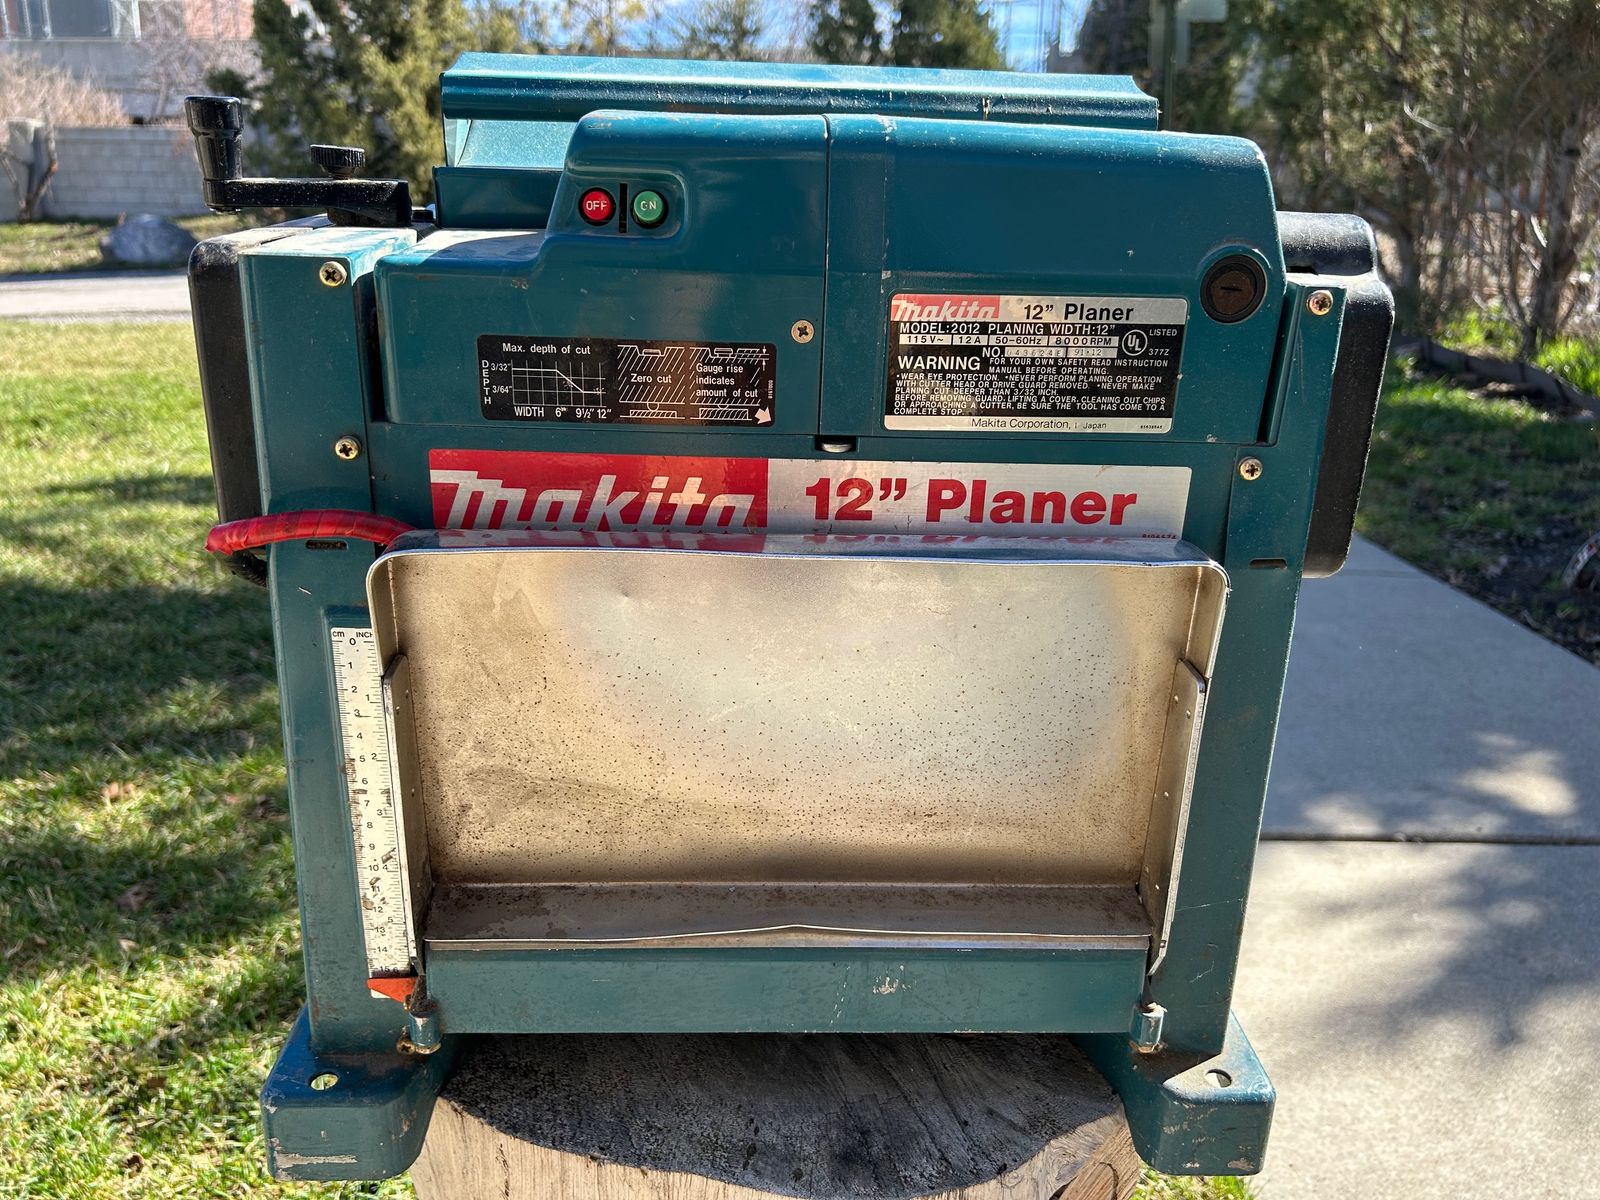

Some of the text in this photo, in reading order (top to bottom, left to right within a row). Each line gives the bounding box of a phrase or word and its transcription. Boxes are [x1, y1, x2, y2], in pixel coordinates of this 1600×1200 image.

[586, 200, 607, 211] OFF
[1064, 303, 1134, 321] Planer
[900, 322, 980, 334] MODEL:2012
[988, 323, 1044, 335] PLANING
[1149, 328, 1177, 336] LISTED
[502, 343, 591, 354] Max. depth of cut
[982, 347, 1004, 358] NO.
[1148, 348, 1170, 356] 377Z
[696, 363, 743, 373] Gauge rise
[898, 356, 980, 370] WARNING
[989, 366, 1022, 374] MANUAL
[631, 373, 672, 383] Zero cut
[696, 375, 735, 385] indicates
[920, 380, 951, 388] CUTTER
[992, 381, 1015, 389] DRIVE
[696, 387, 727, 397] amount
[733, 388, 741, 397] of
[744, 388, 758, 398] cut
[895, 387, 930, 395] PLANING
[988, 388, 1010, 396] THAN
[1007, 395, 1037, 403] LIFTING
[1081, 396, 1120, 404] CLEANING
[893, 407, 937, 415] COMPLETE
[909, 401, 967, 409] APPROACHING
[1100, 403, 1117, 411] HAS
[1119, 403, 1142, 411] COME
[514, 406, 544, 417] WIDTH
[971, 418, 1006, 428] Makita
[1083, 422, 1107, 431] Japan
[926, 478, 1137, 526] Planer
